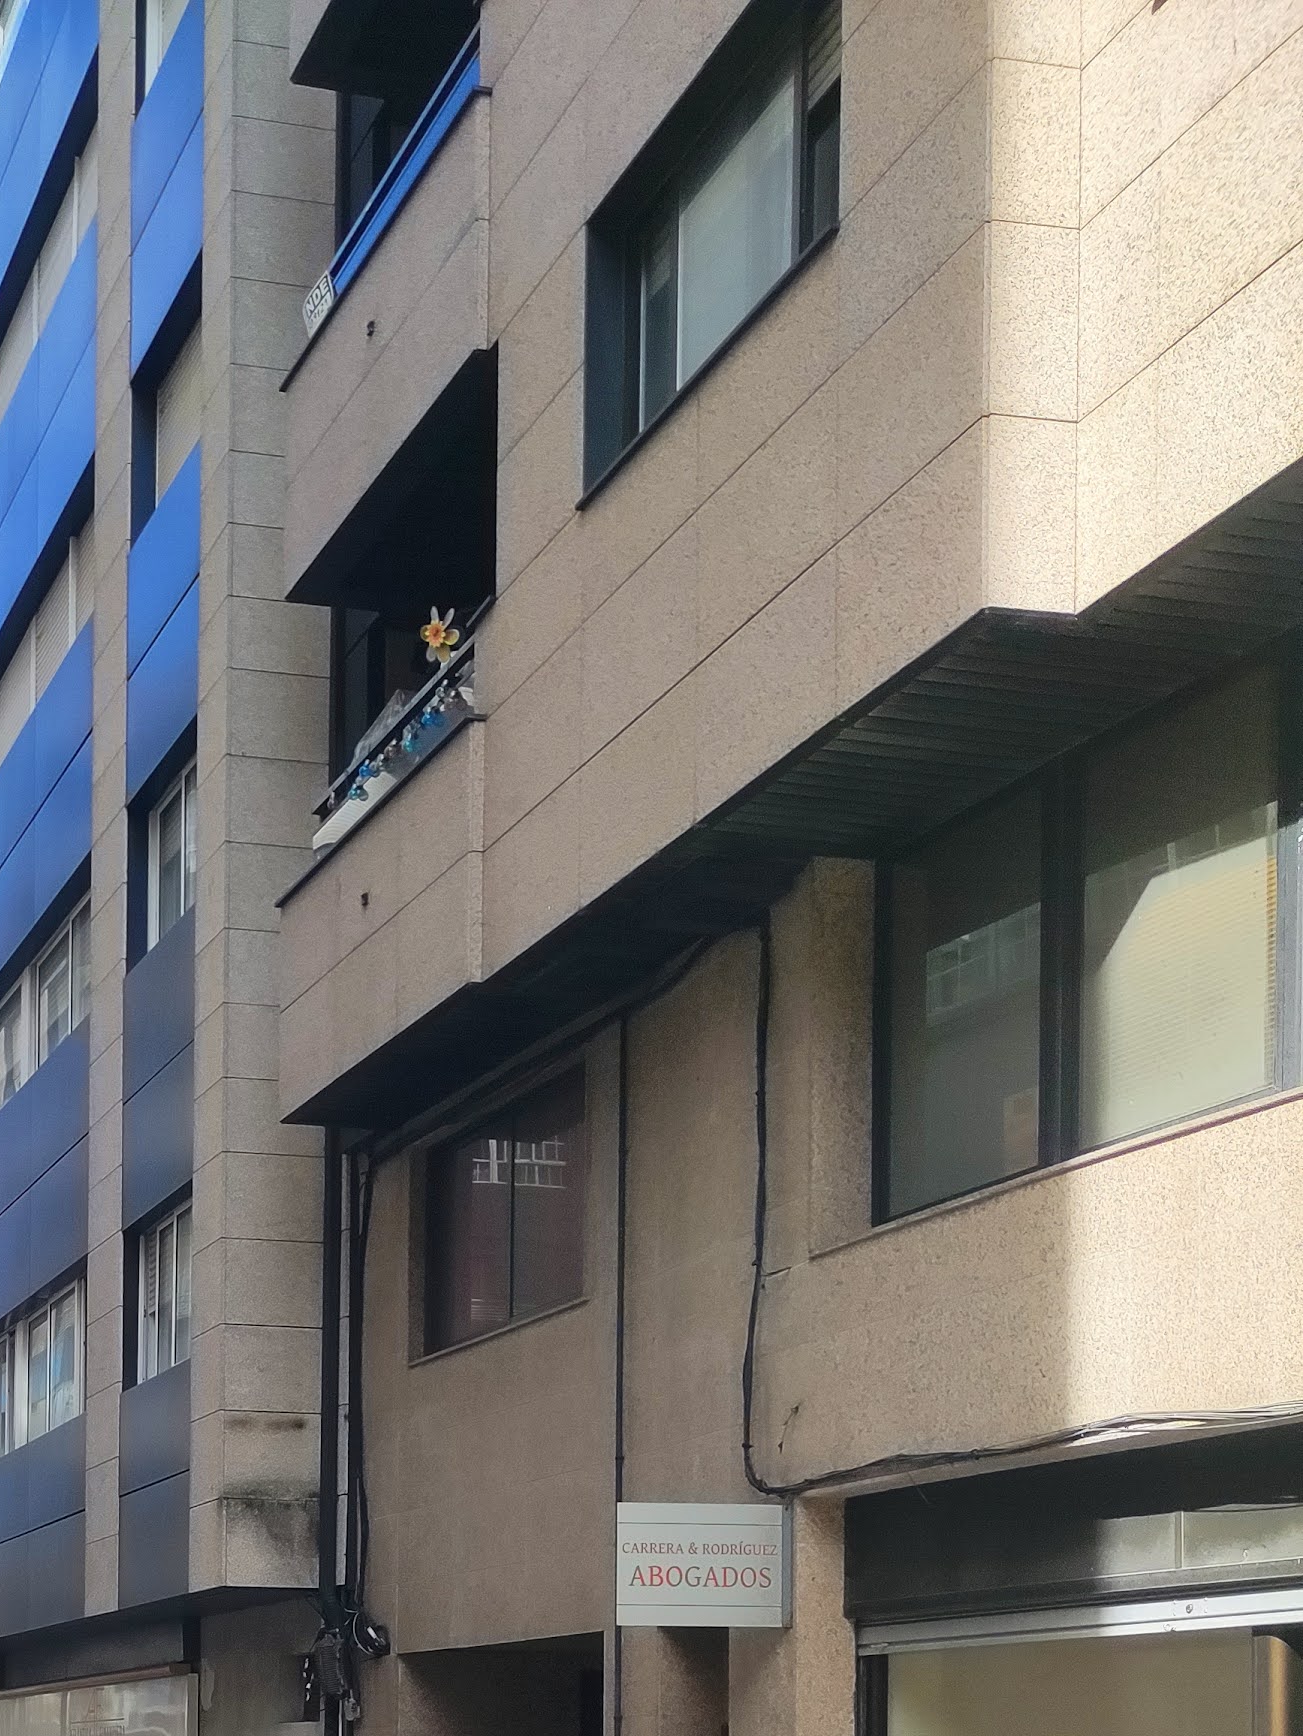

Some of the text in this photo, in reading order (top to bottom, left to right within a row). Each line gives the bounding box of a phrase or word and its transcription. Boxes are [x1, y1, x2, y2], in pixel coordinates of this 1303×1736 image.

[621, 1540, 779, 1556] CARRERA & RODRÍGUEZ
[628, 1564, 773, 1588] ABOGADOS
